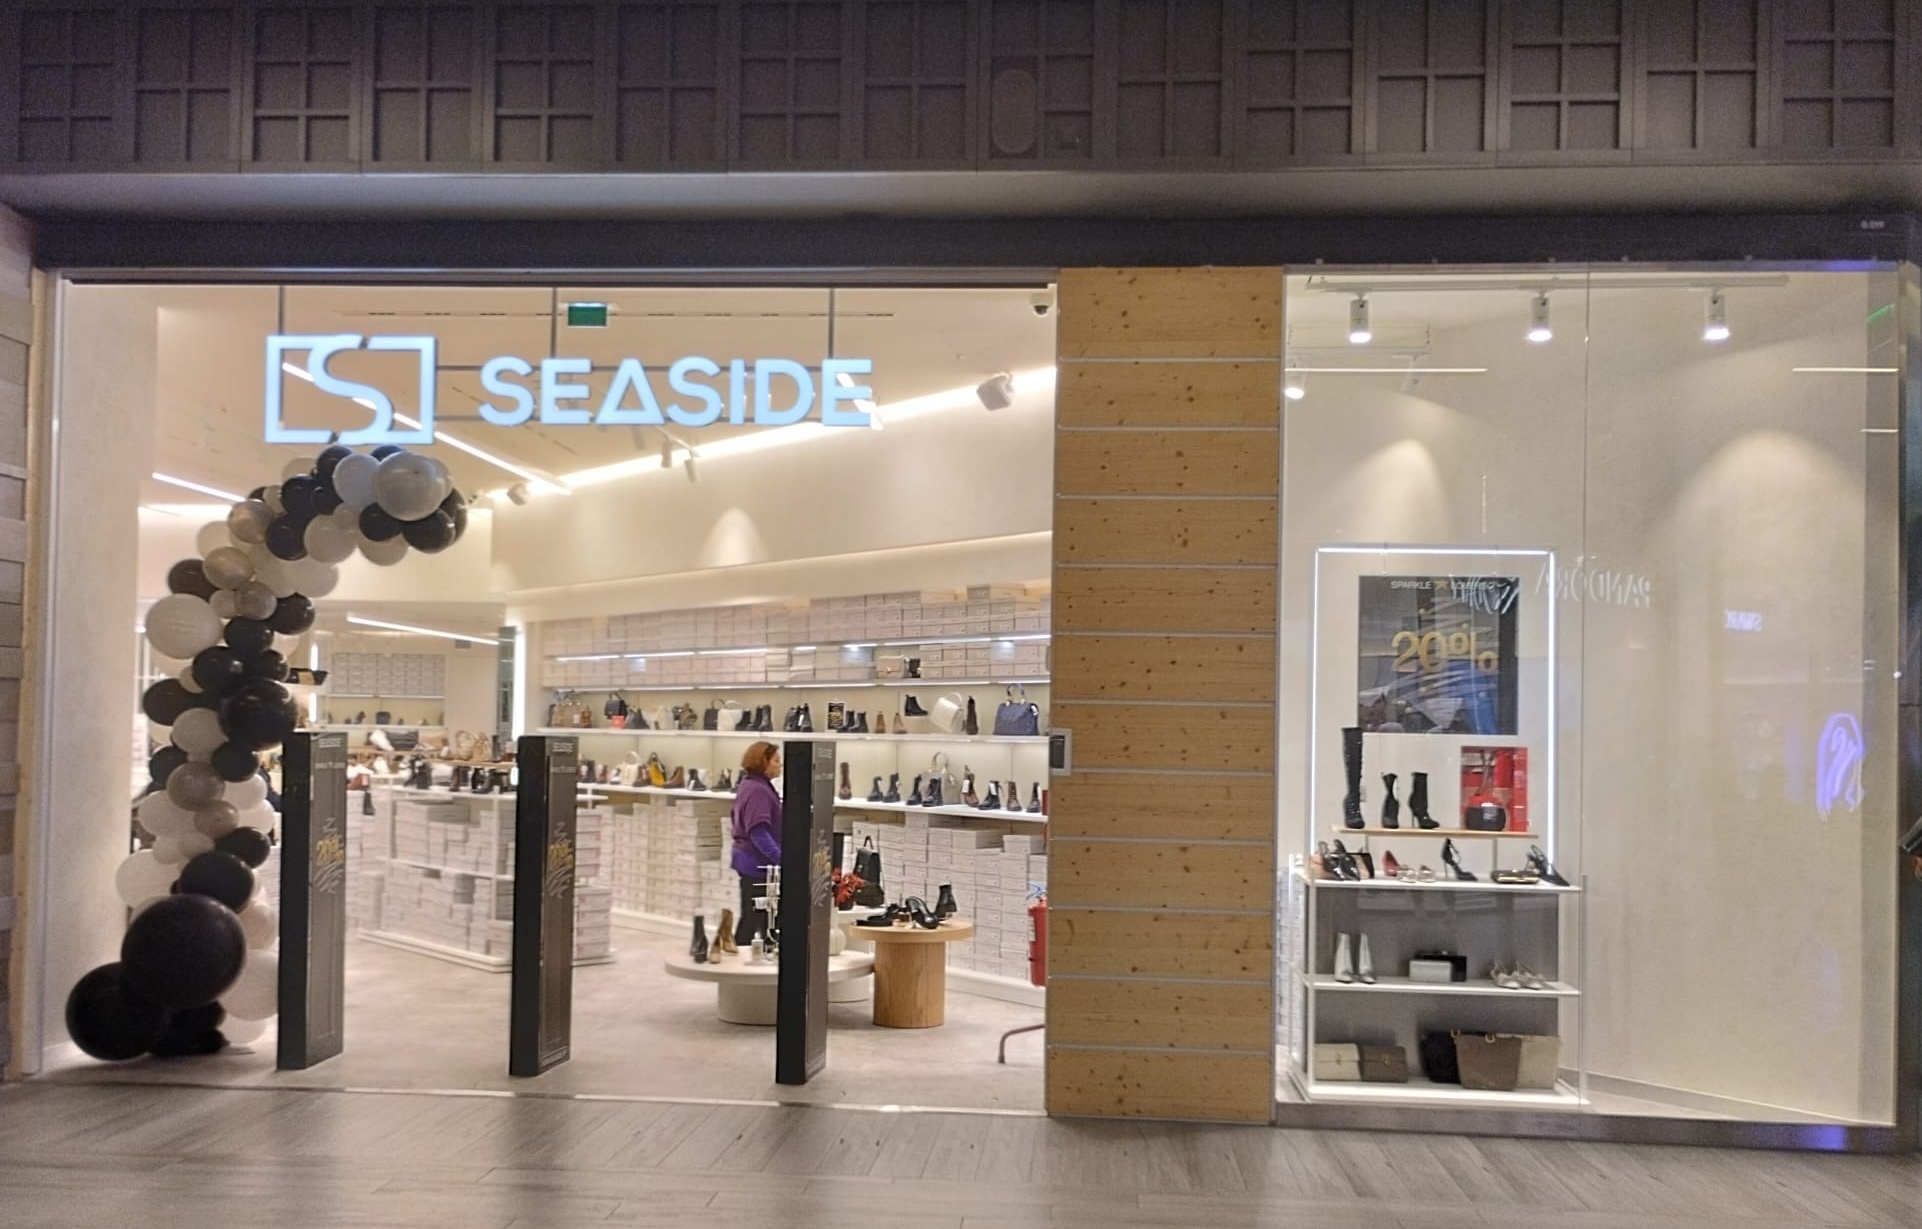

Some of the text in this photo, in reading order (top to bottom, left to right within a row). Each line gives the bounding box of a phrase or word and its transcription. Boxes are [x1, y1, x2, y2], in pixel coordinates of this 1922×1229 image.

[478, 356, 875, 427] SEASIDE
[1390, 580, 1433, 590] SPARKLE
[1390, 630, 1499, 674] 20%
